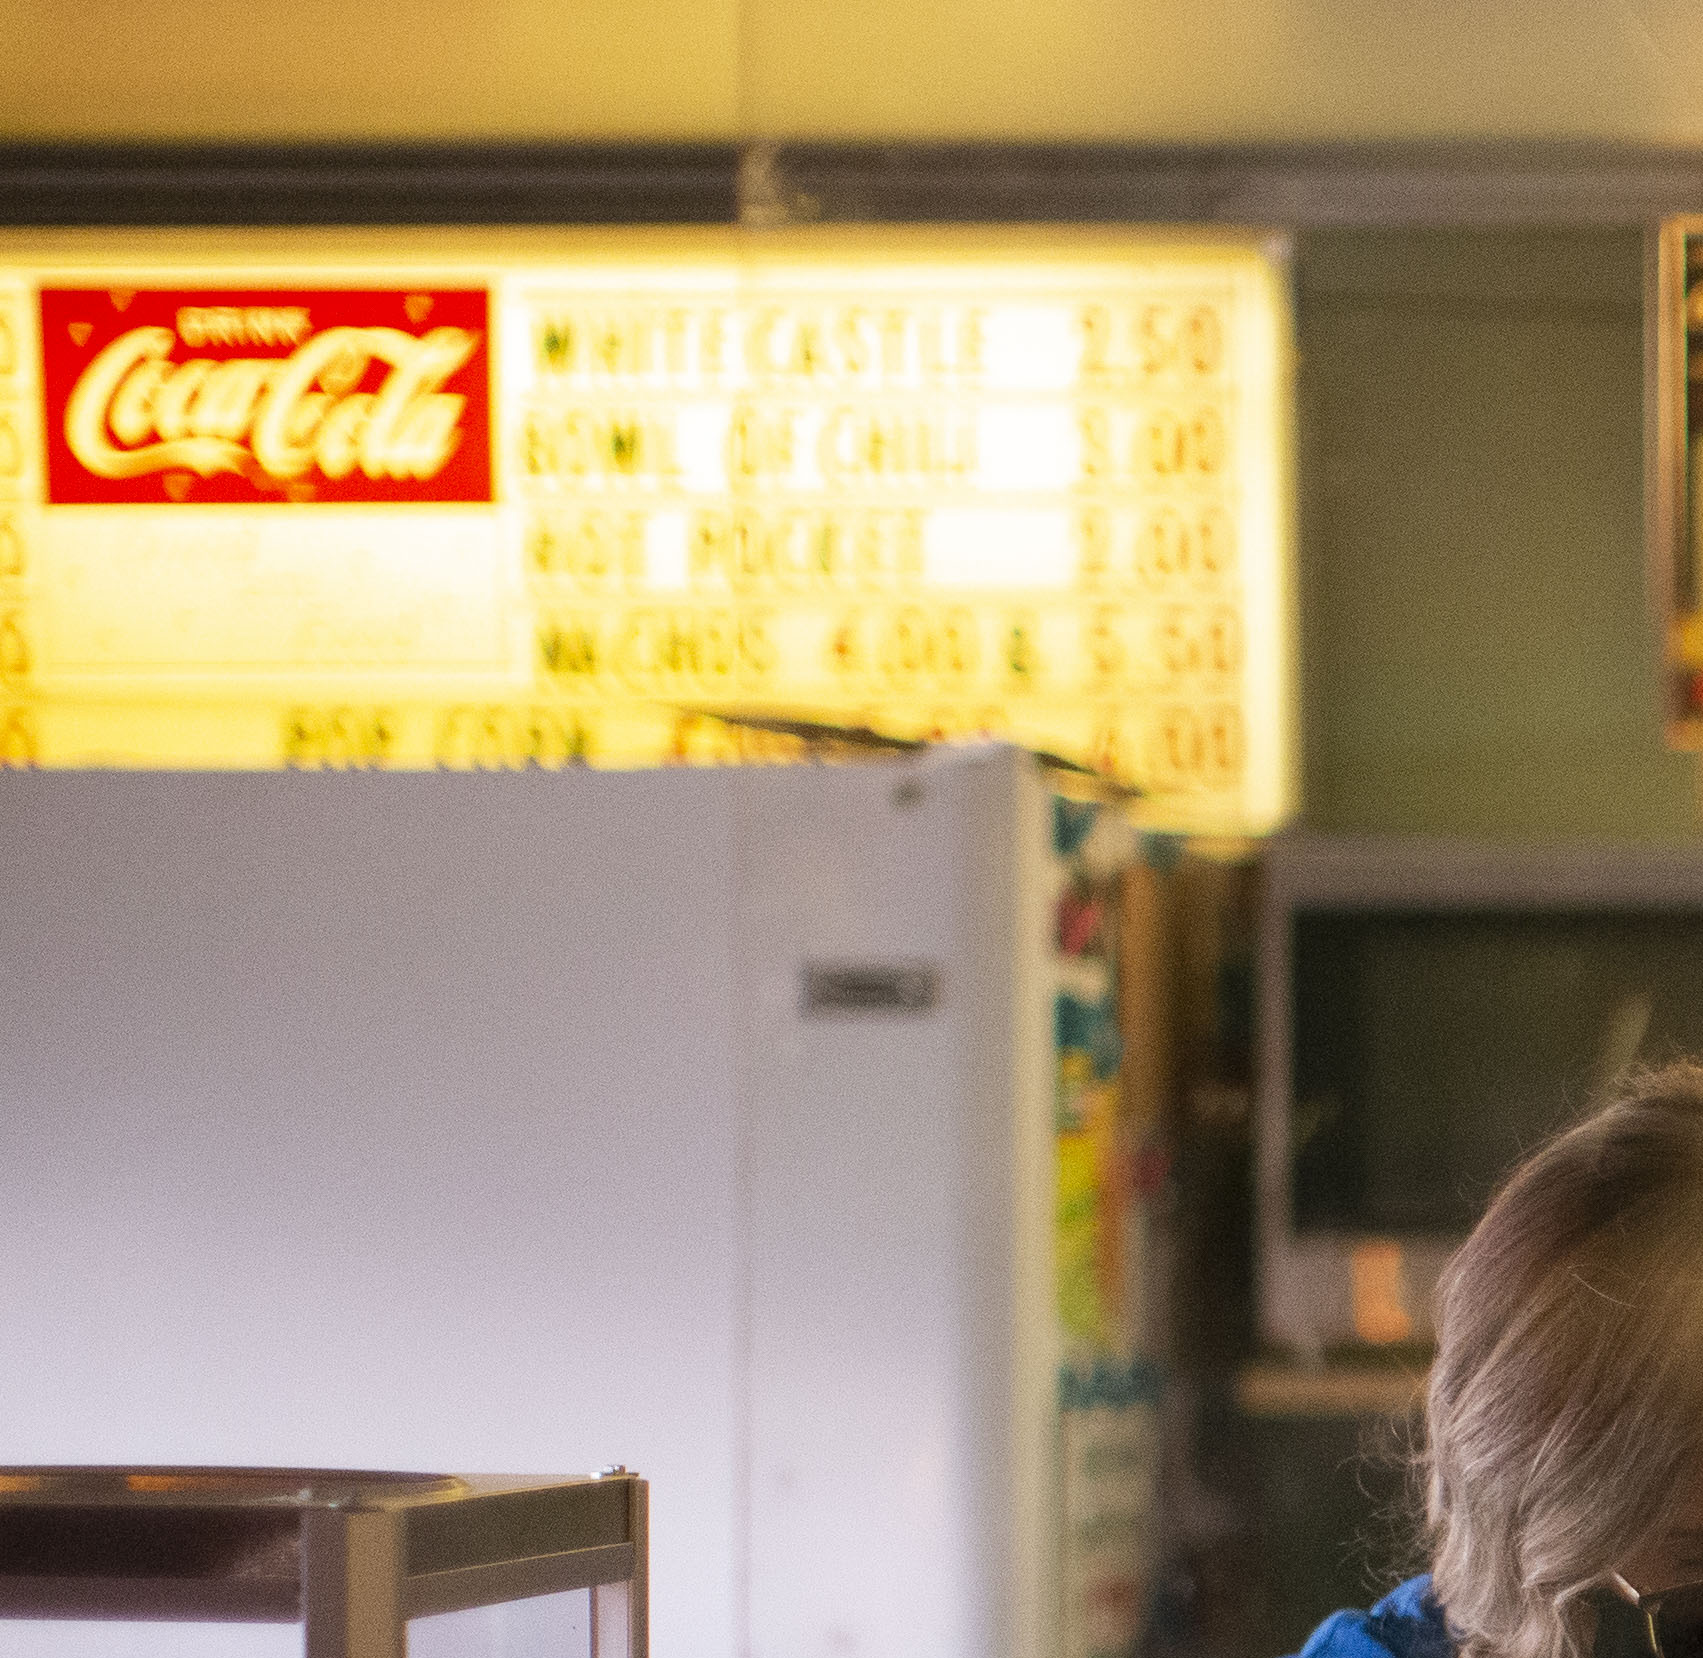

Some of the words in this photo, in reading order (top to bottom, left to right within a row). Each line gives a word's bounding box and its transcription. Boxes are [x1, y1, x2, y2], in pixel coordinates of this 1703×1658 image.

[177, 306, 311, 348] DRINK
[66, 326, 477, 480] Coca-Cola
[519, 405, 681, 477] BOWL
[730, 405, 796, 477] OF
[818, 405, 979, 477] CHILI
[526, 506, 646, 577] HOT
[690, 506, 926, 577] POCKET
[537, 604, 776, 677] NACHOS
